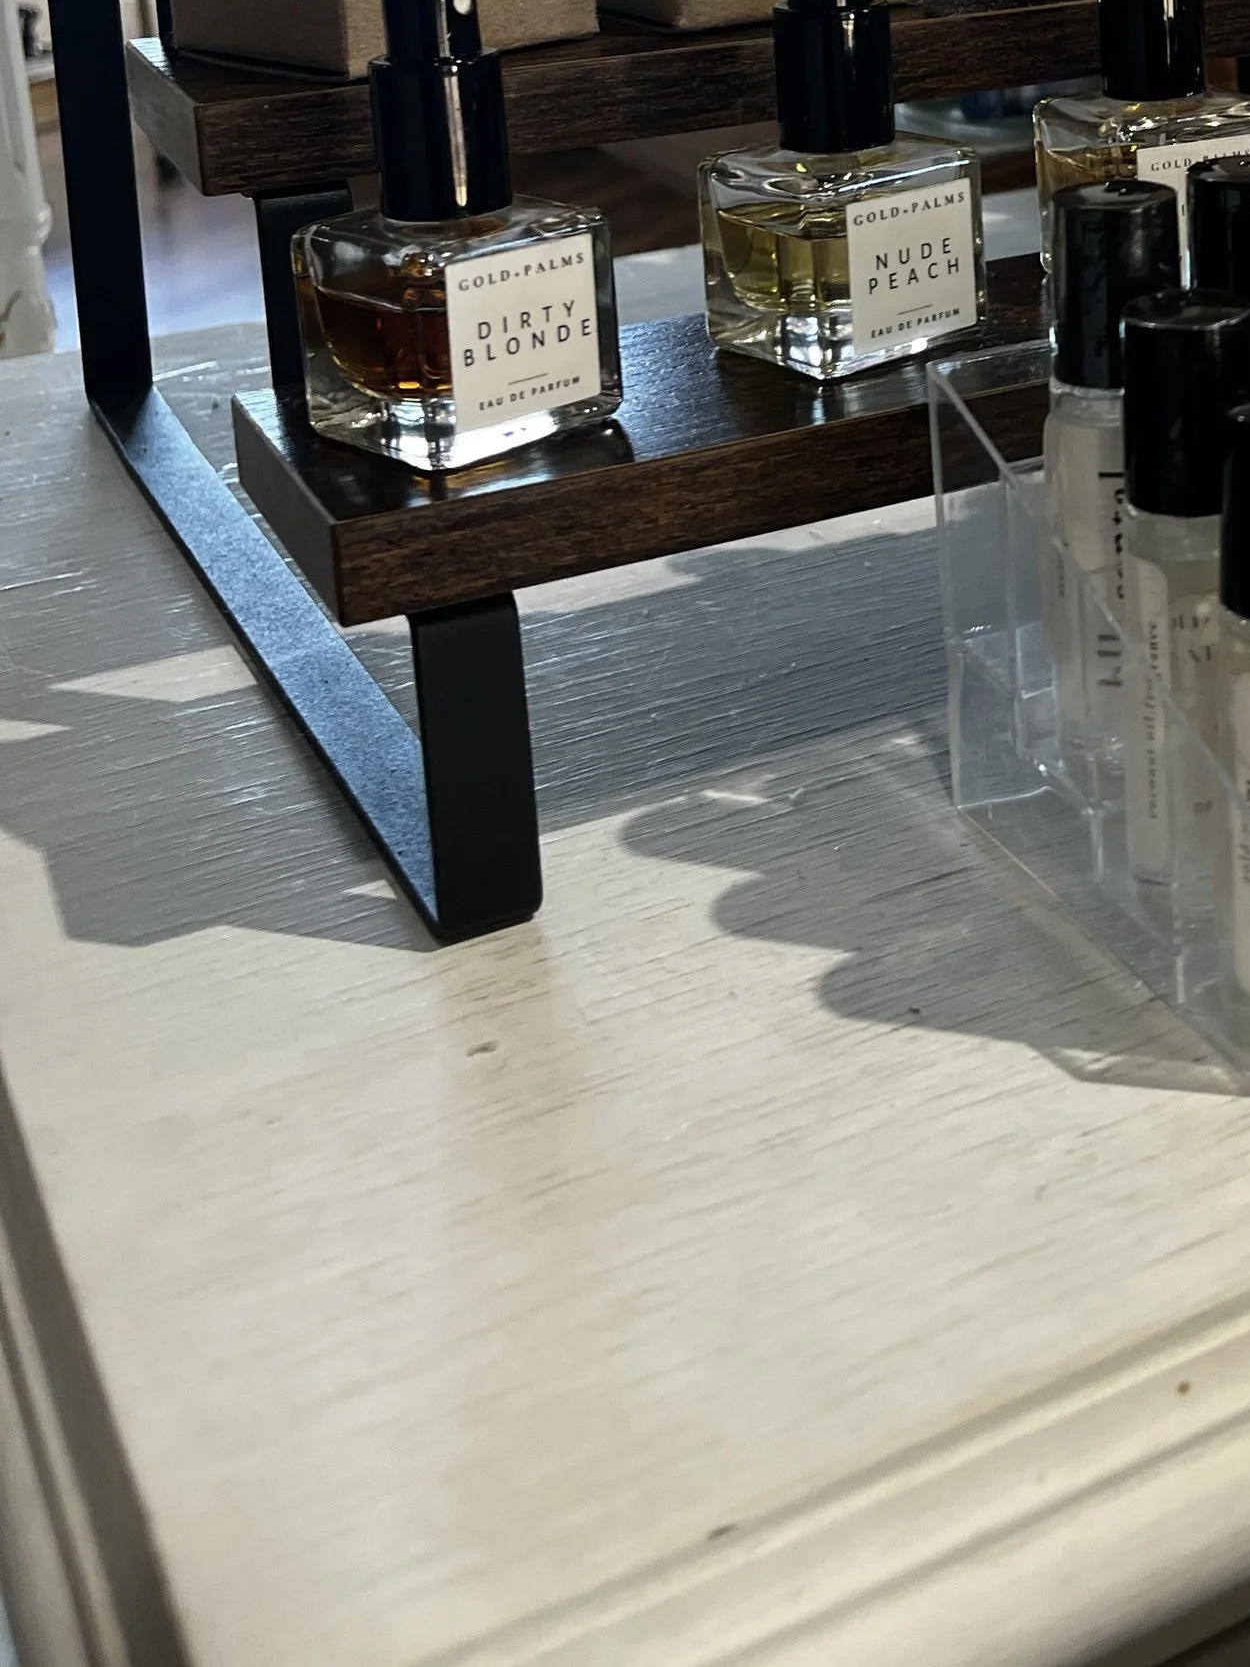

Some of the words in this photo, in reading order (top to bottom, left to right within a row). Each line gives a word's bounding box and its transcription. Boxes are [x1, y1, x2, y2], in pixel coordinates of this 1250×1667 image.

[876, 237, 952, 271] NUDE
[868, 257, 960, 295] PEACH
[477, 299, 575, 340] DIRTY
[871, 326, 893, 339] EAU
[898, 320, 912, 331] DE
[917, 308, 960, 324] PARFUM
[464, 318, 592, 367] BLONDE
[479, 396, 504, 411] EAU
[510, 390, 526, 403] DE
[531, 376, 581, 397] PARFUM
